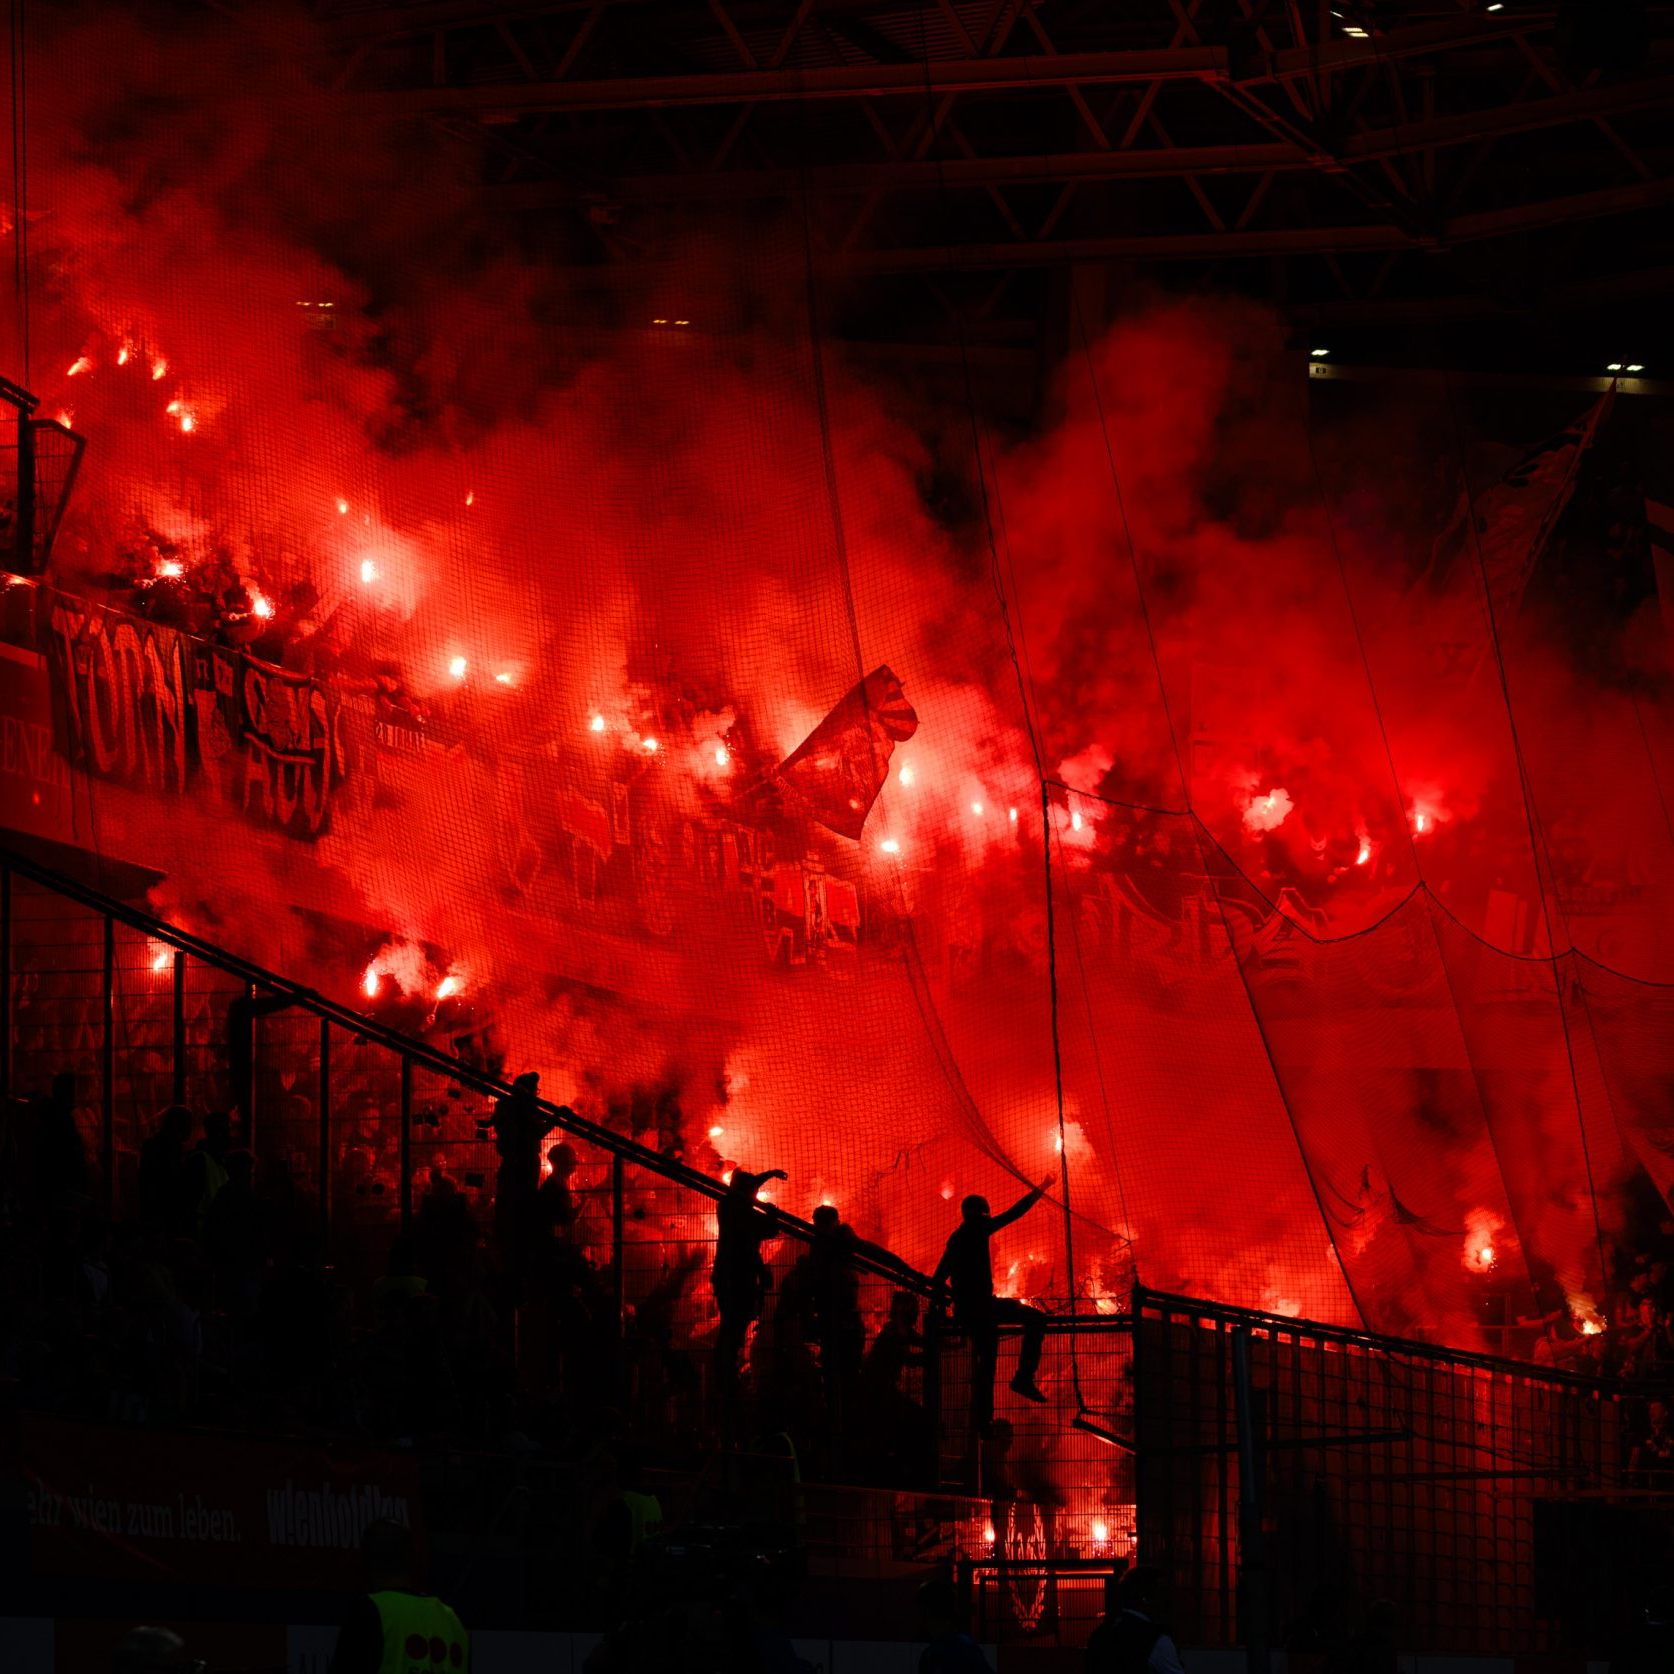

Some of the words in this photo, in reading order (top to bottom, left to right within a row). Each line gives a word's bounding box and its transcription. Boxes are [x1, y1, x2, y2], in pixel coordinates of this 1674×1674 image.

[67, 1483, 123, 1534] wien
[127, 1503, 175, 1539] zum
[176, 1491, 241, 1543] leben.
